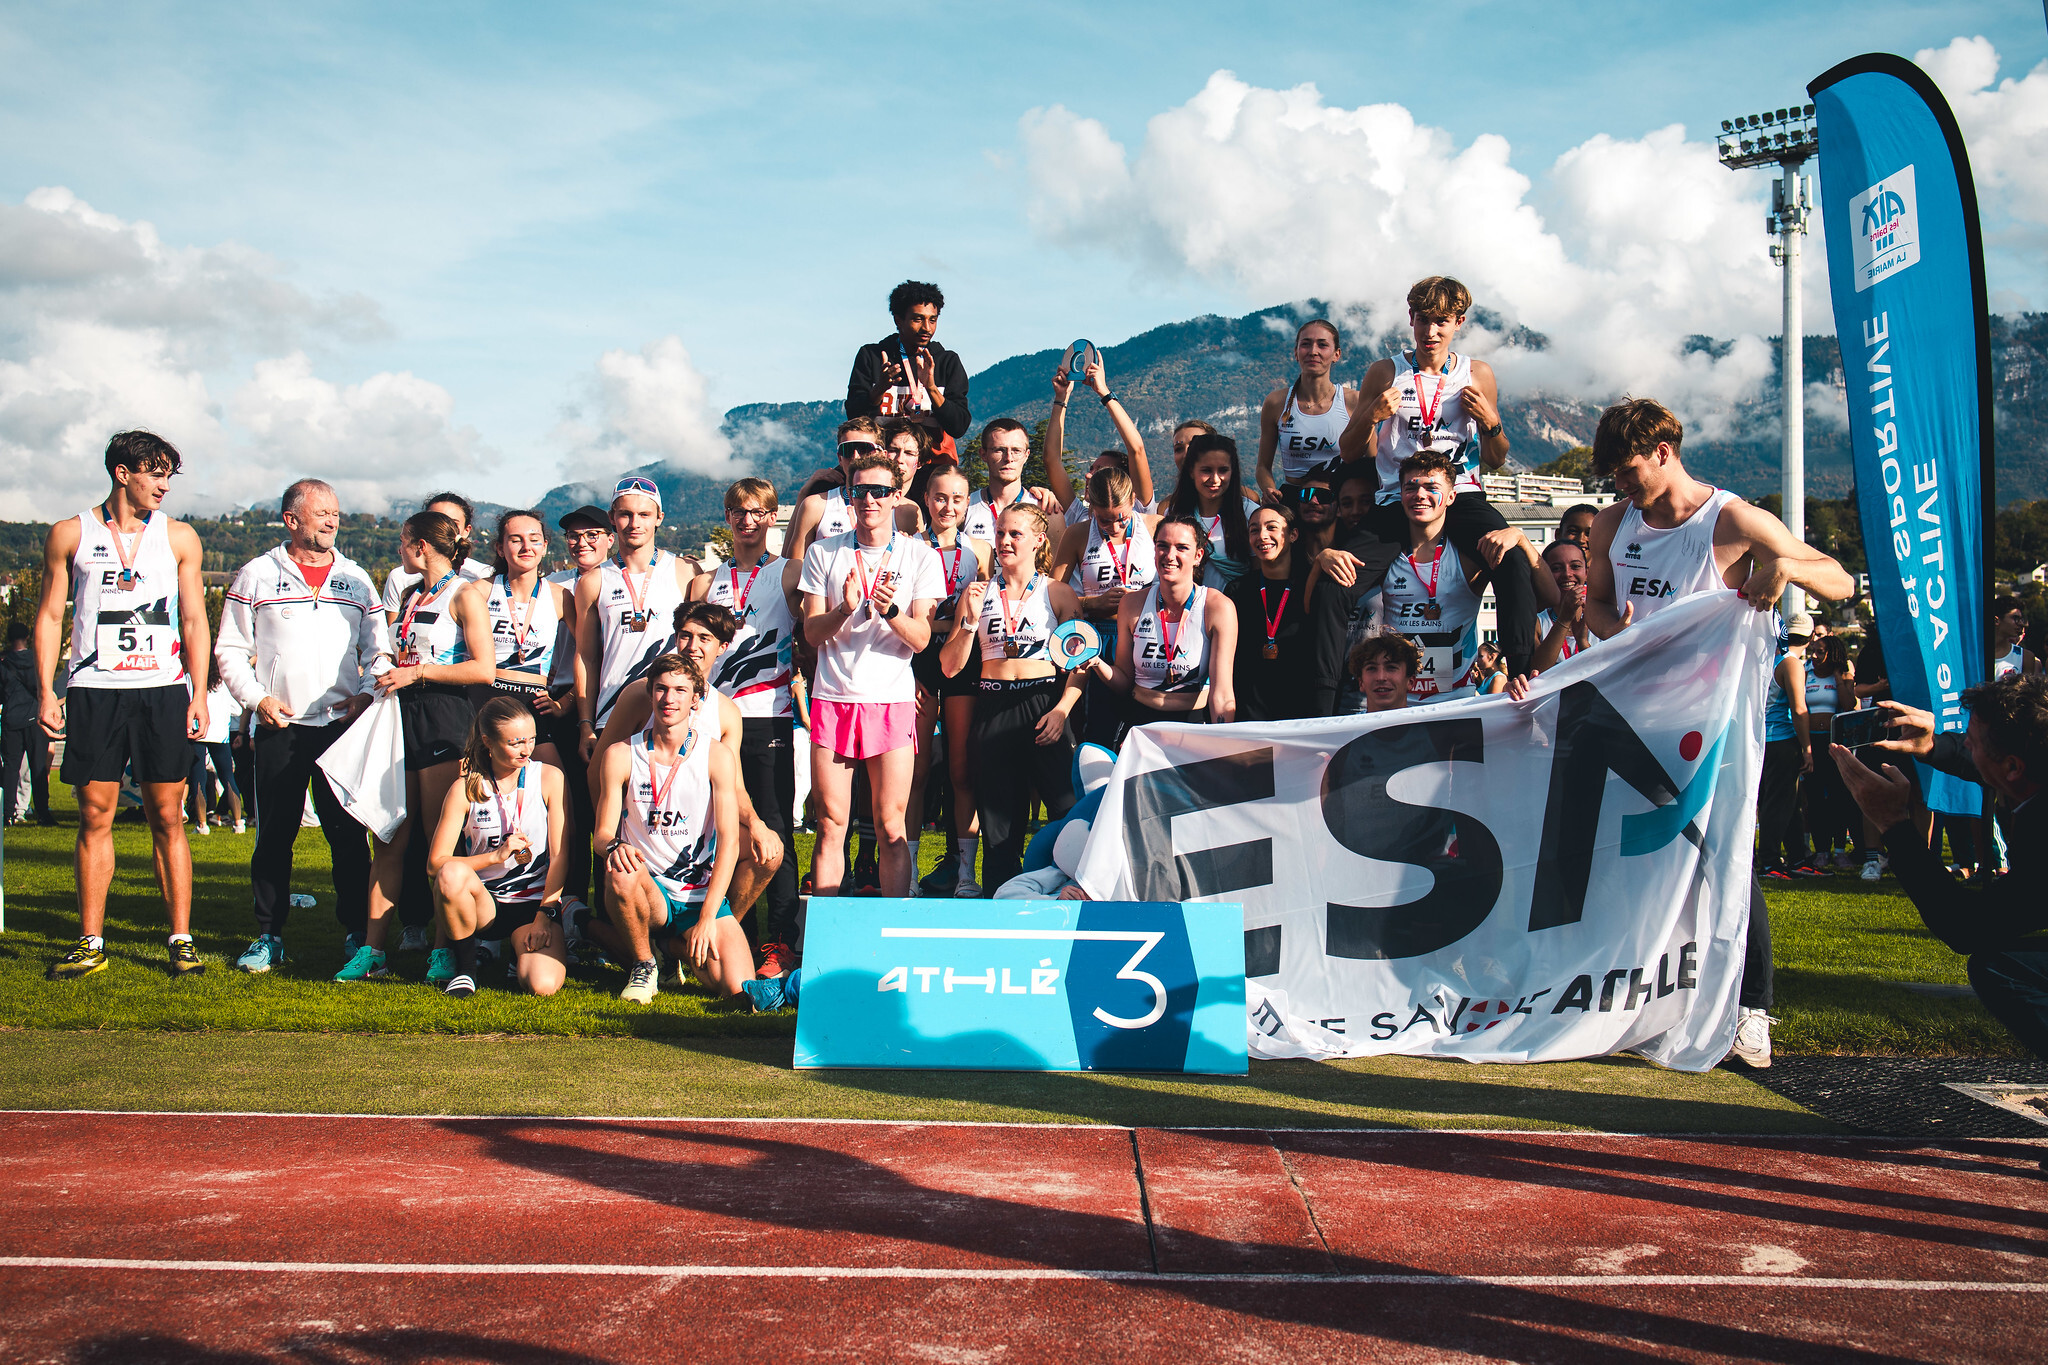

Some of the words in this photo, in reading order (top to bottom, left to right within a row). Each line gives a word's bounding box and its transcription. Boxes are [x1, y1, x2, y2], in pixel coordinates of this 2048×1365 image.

[1289, 435, 1336, 451] ESA
[1629, 577, 1678, 599] ESA
[1015, 634, 1037, 642] BAINS
[123, 657, 156, 668] MAIF
[1412, 680, 1436, 691] AIF
[1121, 680, 1734, 978] ESA
[876, 957, 1060, 995] ATHLÉ
[1092, 930, 1169, 1030] 3
